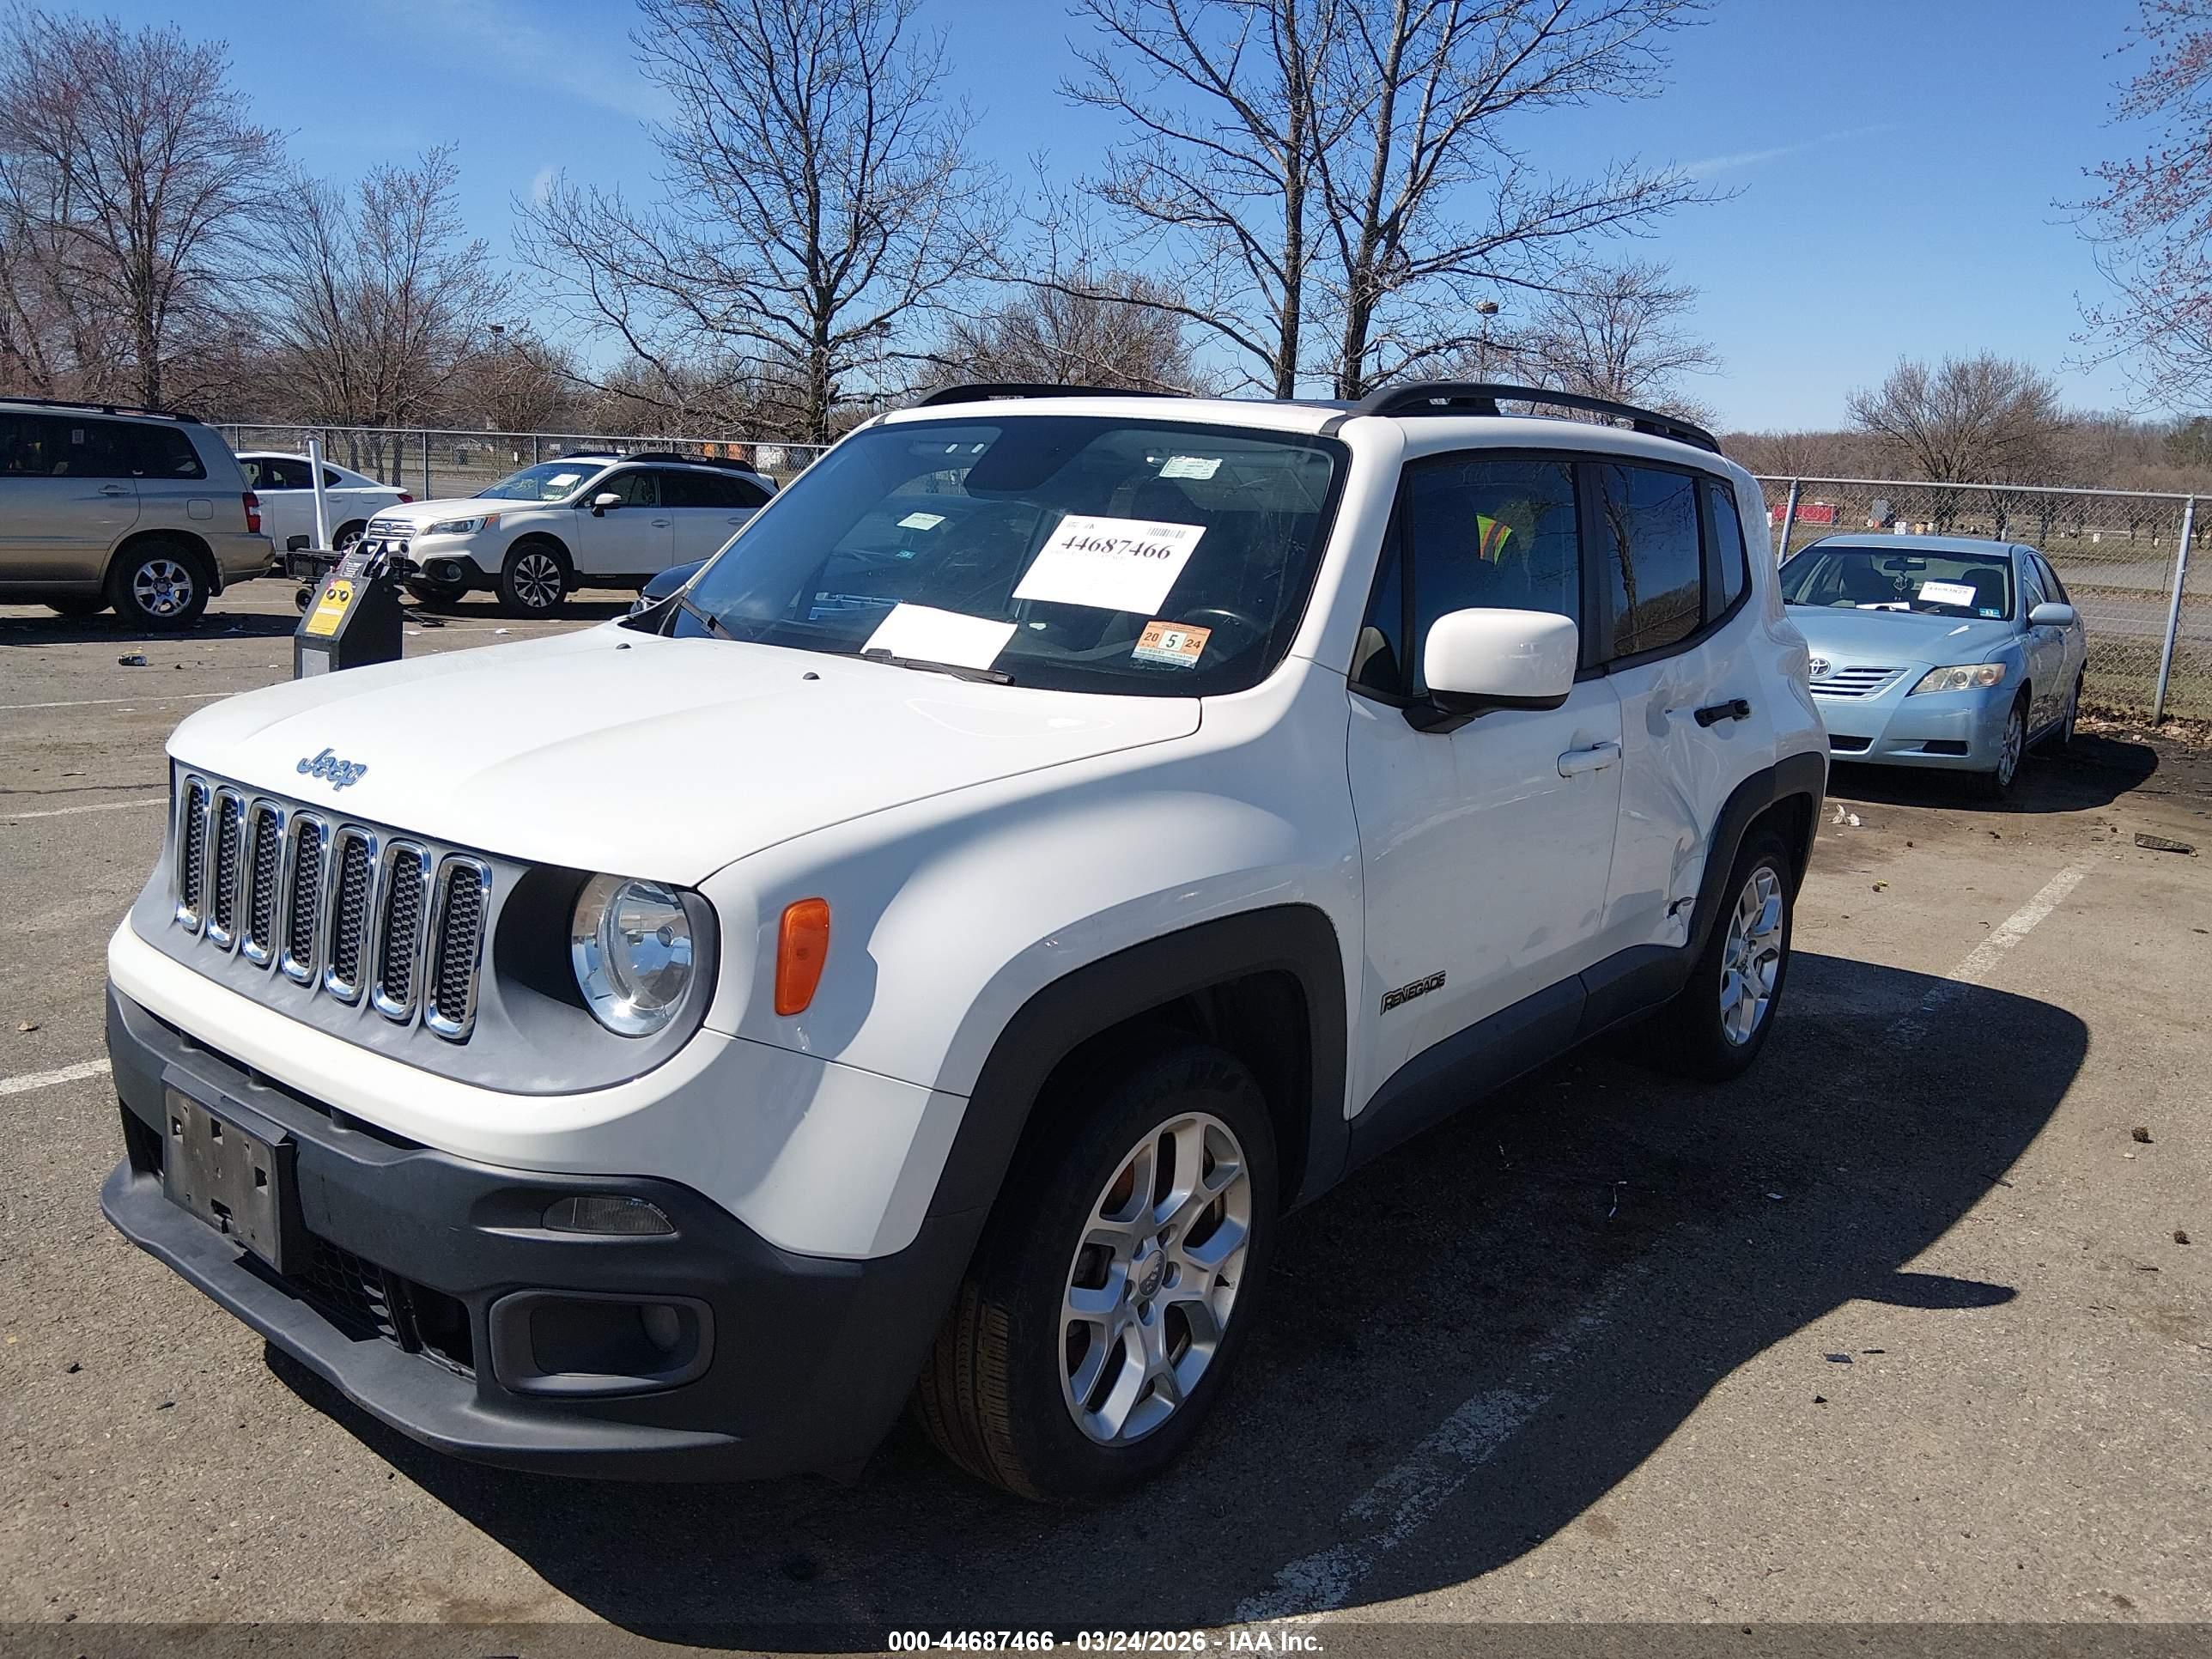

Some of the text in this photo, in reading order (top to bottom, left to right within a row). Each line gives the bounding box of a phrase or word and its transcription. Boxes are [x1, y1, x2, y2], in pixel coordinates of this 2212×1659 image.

[1060, 535, 1175, 561] 44687466
[1143, 631, 1202, 649] 20 5 24
[296, 747, 368, 792] Jeep
[1380, 969, 1446, 1017] RENEGADE
